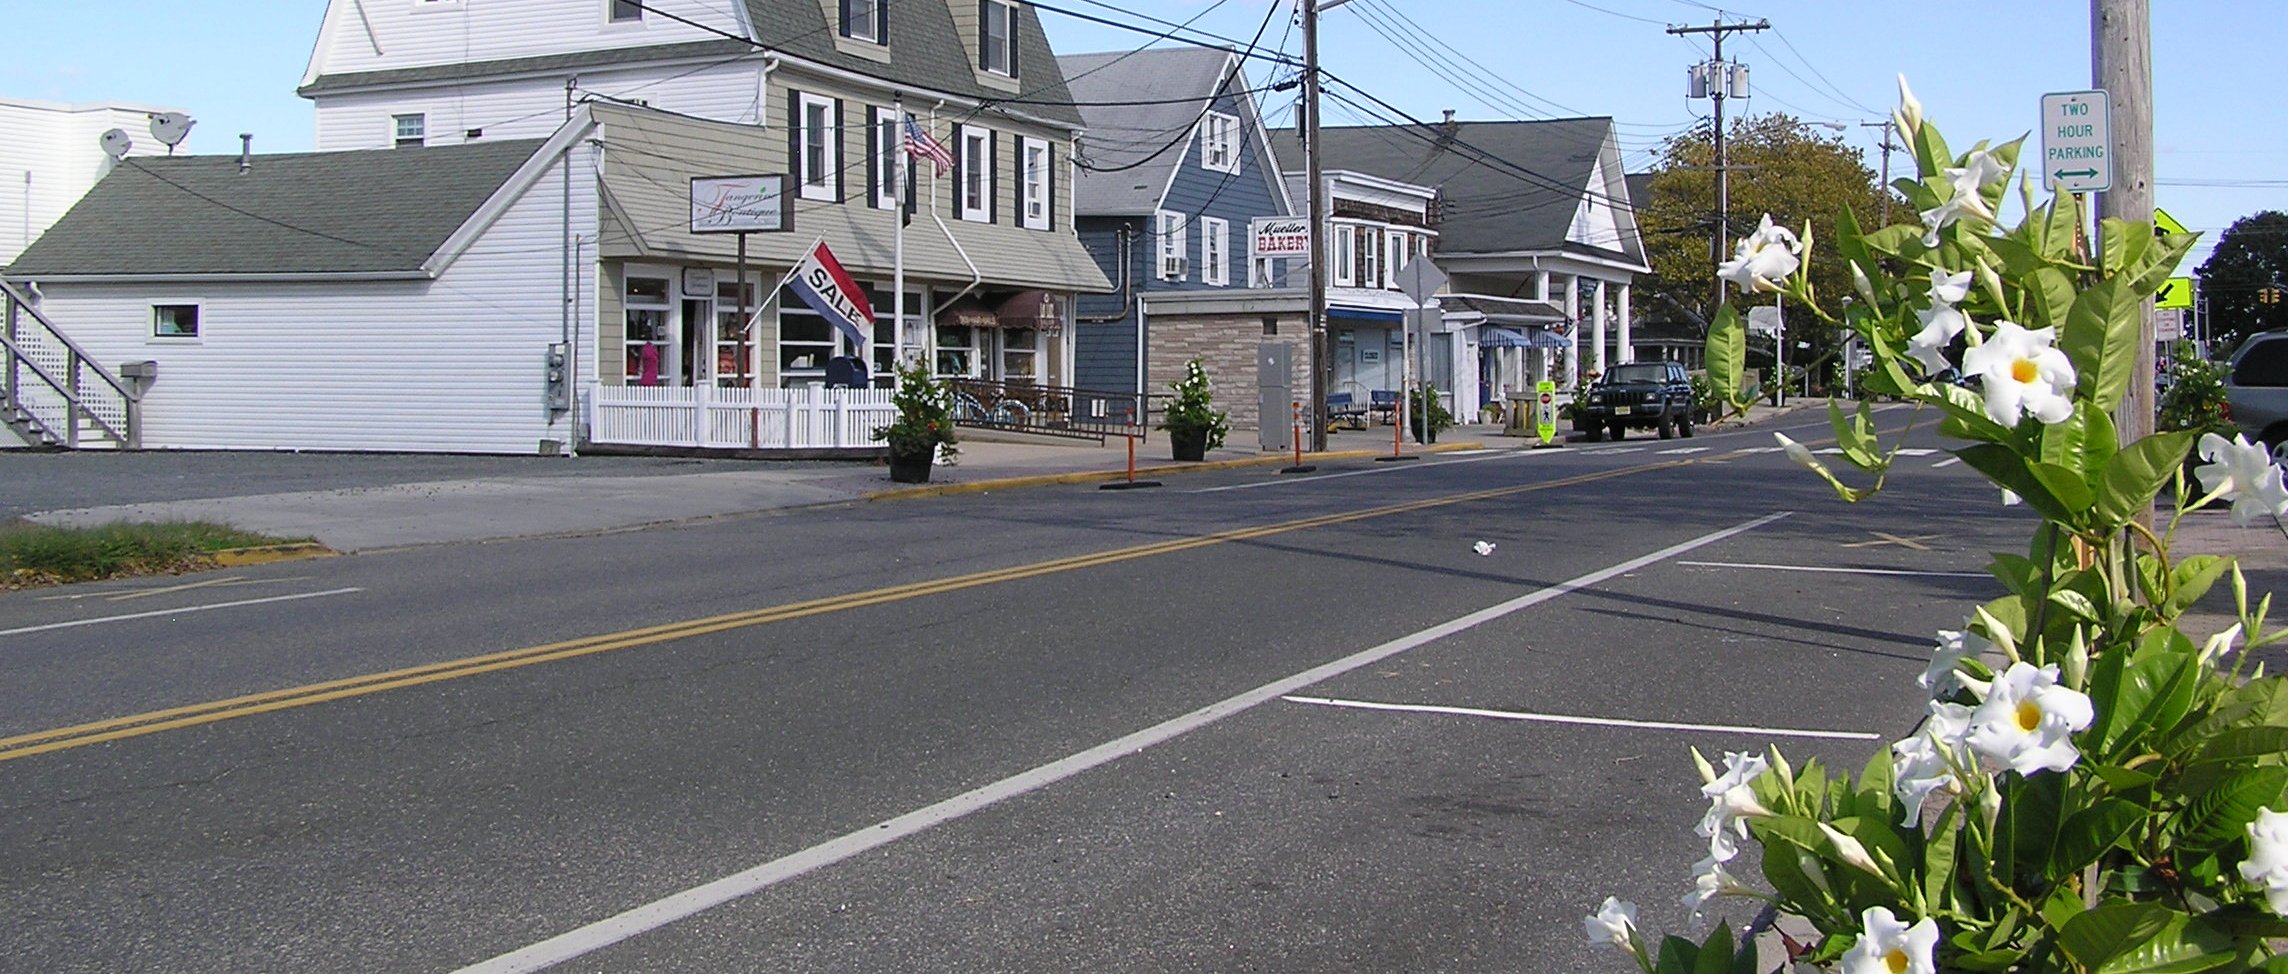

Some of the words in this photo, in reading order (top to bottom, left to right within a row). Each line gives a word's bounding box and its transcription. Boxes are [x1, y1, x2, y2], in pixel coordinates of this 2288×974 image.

[2061, 102, 2089, 117] TWO
[2057, 124, 2093, 138] HOUR
[2048, 145, 2104, 160] PARKING
[809, 268, 862, 327] SALE
